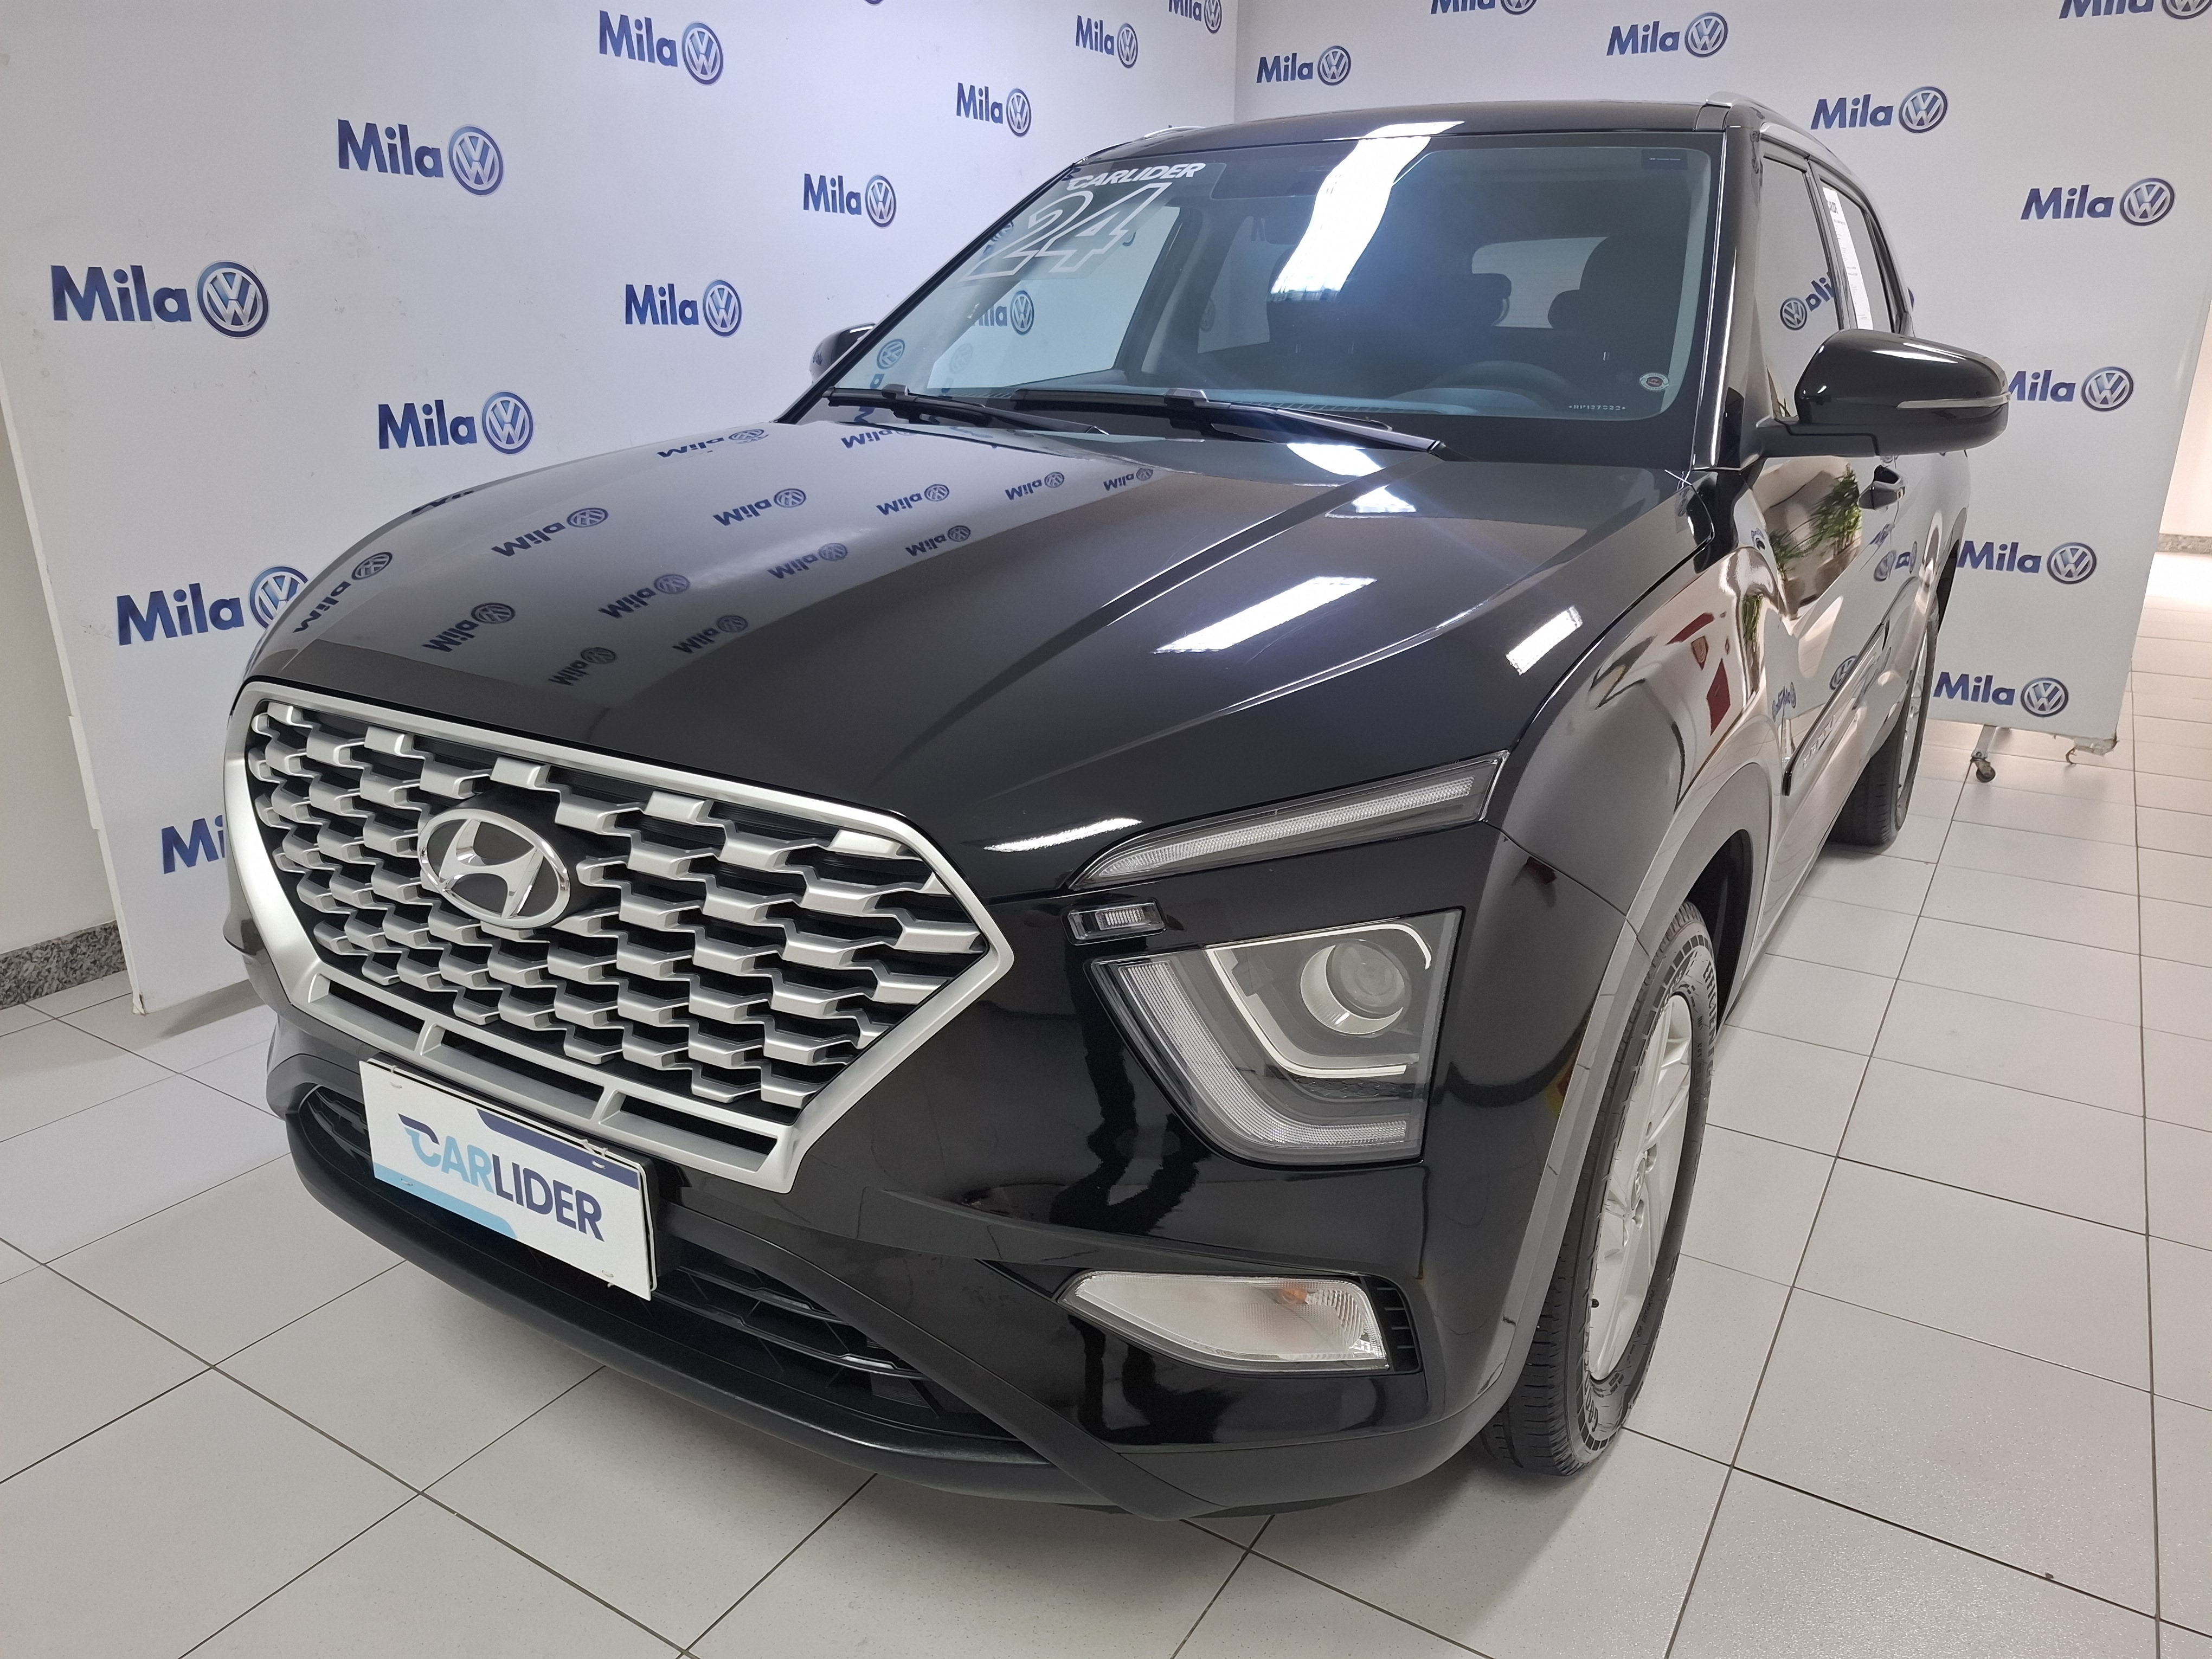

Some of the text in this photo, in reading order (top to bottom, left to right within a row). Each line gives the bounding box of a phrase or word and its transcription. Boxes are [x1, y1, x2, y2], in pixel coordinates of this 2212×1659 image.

[599, 10, 678, 67] Mila
[1075, 15, 1115, 55] Mila
[1606, 21, 1680, 56] Mila
[1256, 53, 1313, 83] Mila
[957, 82, 1003, 124] Mila
[1810, 94, 1894, 130] Mila
[338, 119, 443, 178] Mila
[803, 173, 861, 215] Mila
[1066, 163, 1206, 190] CARLIDER
[2021, 185, 2114, 220] Mila
[50, 265, 192, 323] Mila
[625, 284, 699, 326] Mila
[378, 399, 477, 449] Mila
[1957, 541, 2042, 573] Mila
[117, 583, 245, 646] Mila
[1933, 672, 2015, 705] Mila
[161, 815, 225, 874] Mi
[397, 1113, 605, 1242] CARLIDER
